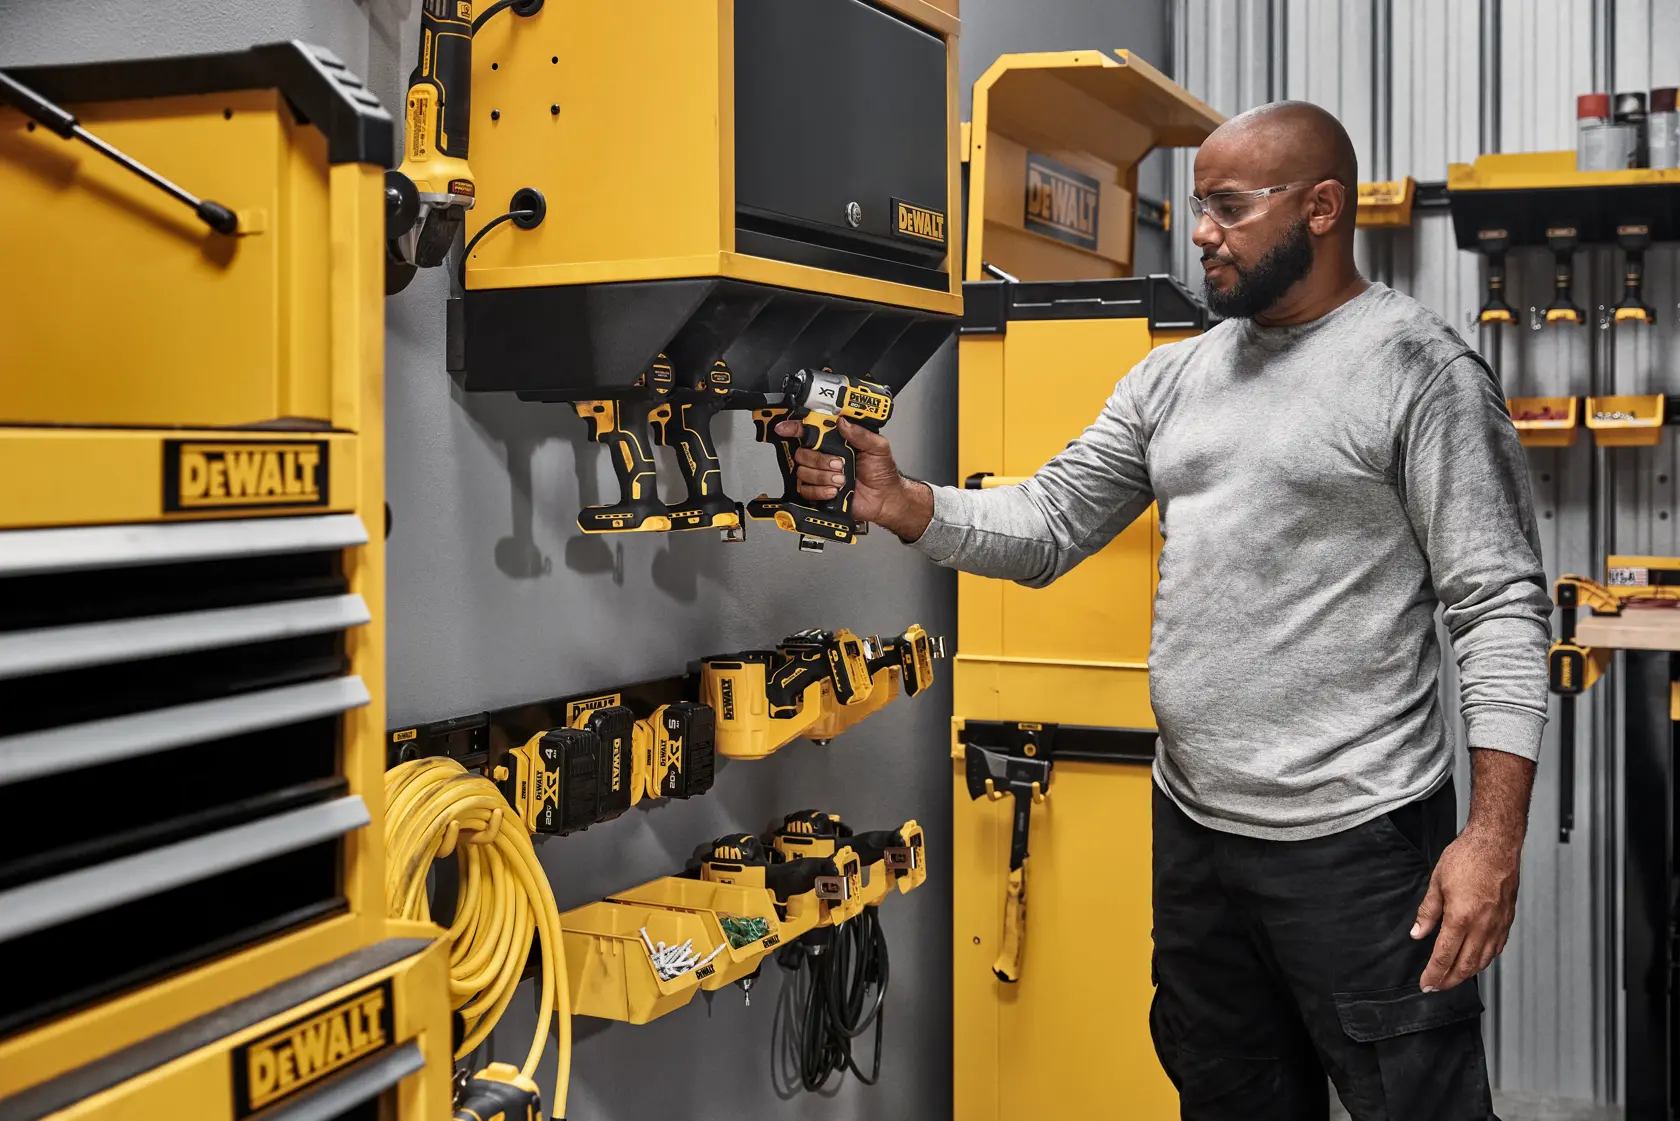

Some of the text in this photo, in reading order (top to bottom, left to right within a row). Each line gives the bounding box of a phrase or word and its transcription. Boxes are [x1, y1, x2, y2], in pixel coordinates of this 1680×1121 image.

[1029, 169, 1096, 234] DEWALT
[899, 206, 944, 239] DEWALT
[819, 386, 835, 398] XR
[850, 391, 881, 407] DEWALT
[180, 451, 319, 497] DEWALT
[722, 679, 734, 720] DEWALT
[668, 719, 676, 729] 5
[545, 748, 553, 759] 4
[612, 738, 621, 791] DEWALT
[667, 737, 682, 772] XR
[543, 769, 560, 807] XR
[695, 963, 715, 980] DEWALT
[251, 997, 385, 1099] DEWALT
